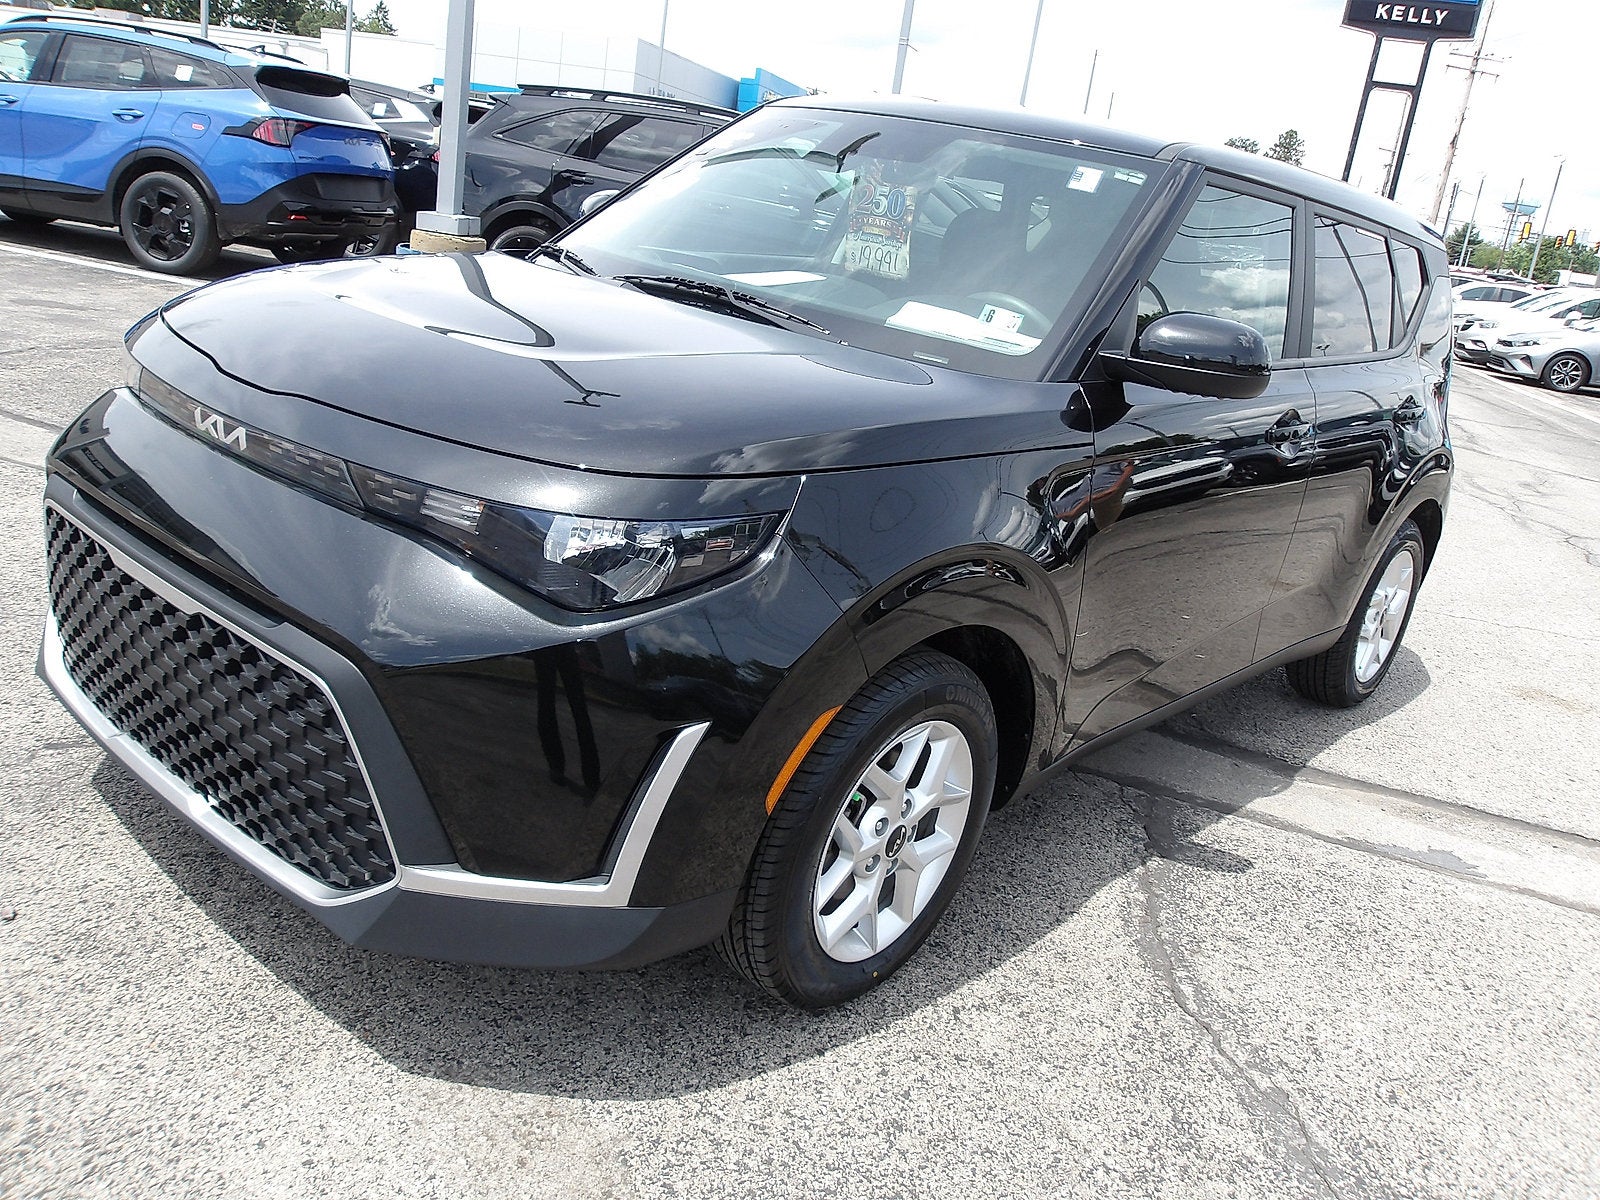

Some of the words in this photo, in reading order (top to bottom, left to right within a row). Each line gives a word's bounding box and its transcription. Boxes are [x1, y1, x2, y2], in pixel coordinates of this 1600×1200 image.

[1375, 3, 1449, 26] KELLY
[854, 183, 907, 220] 250
[863, 217, 892, 228] YEARS
[194, 407, 247, 451] KIA
